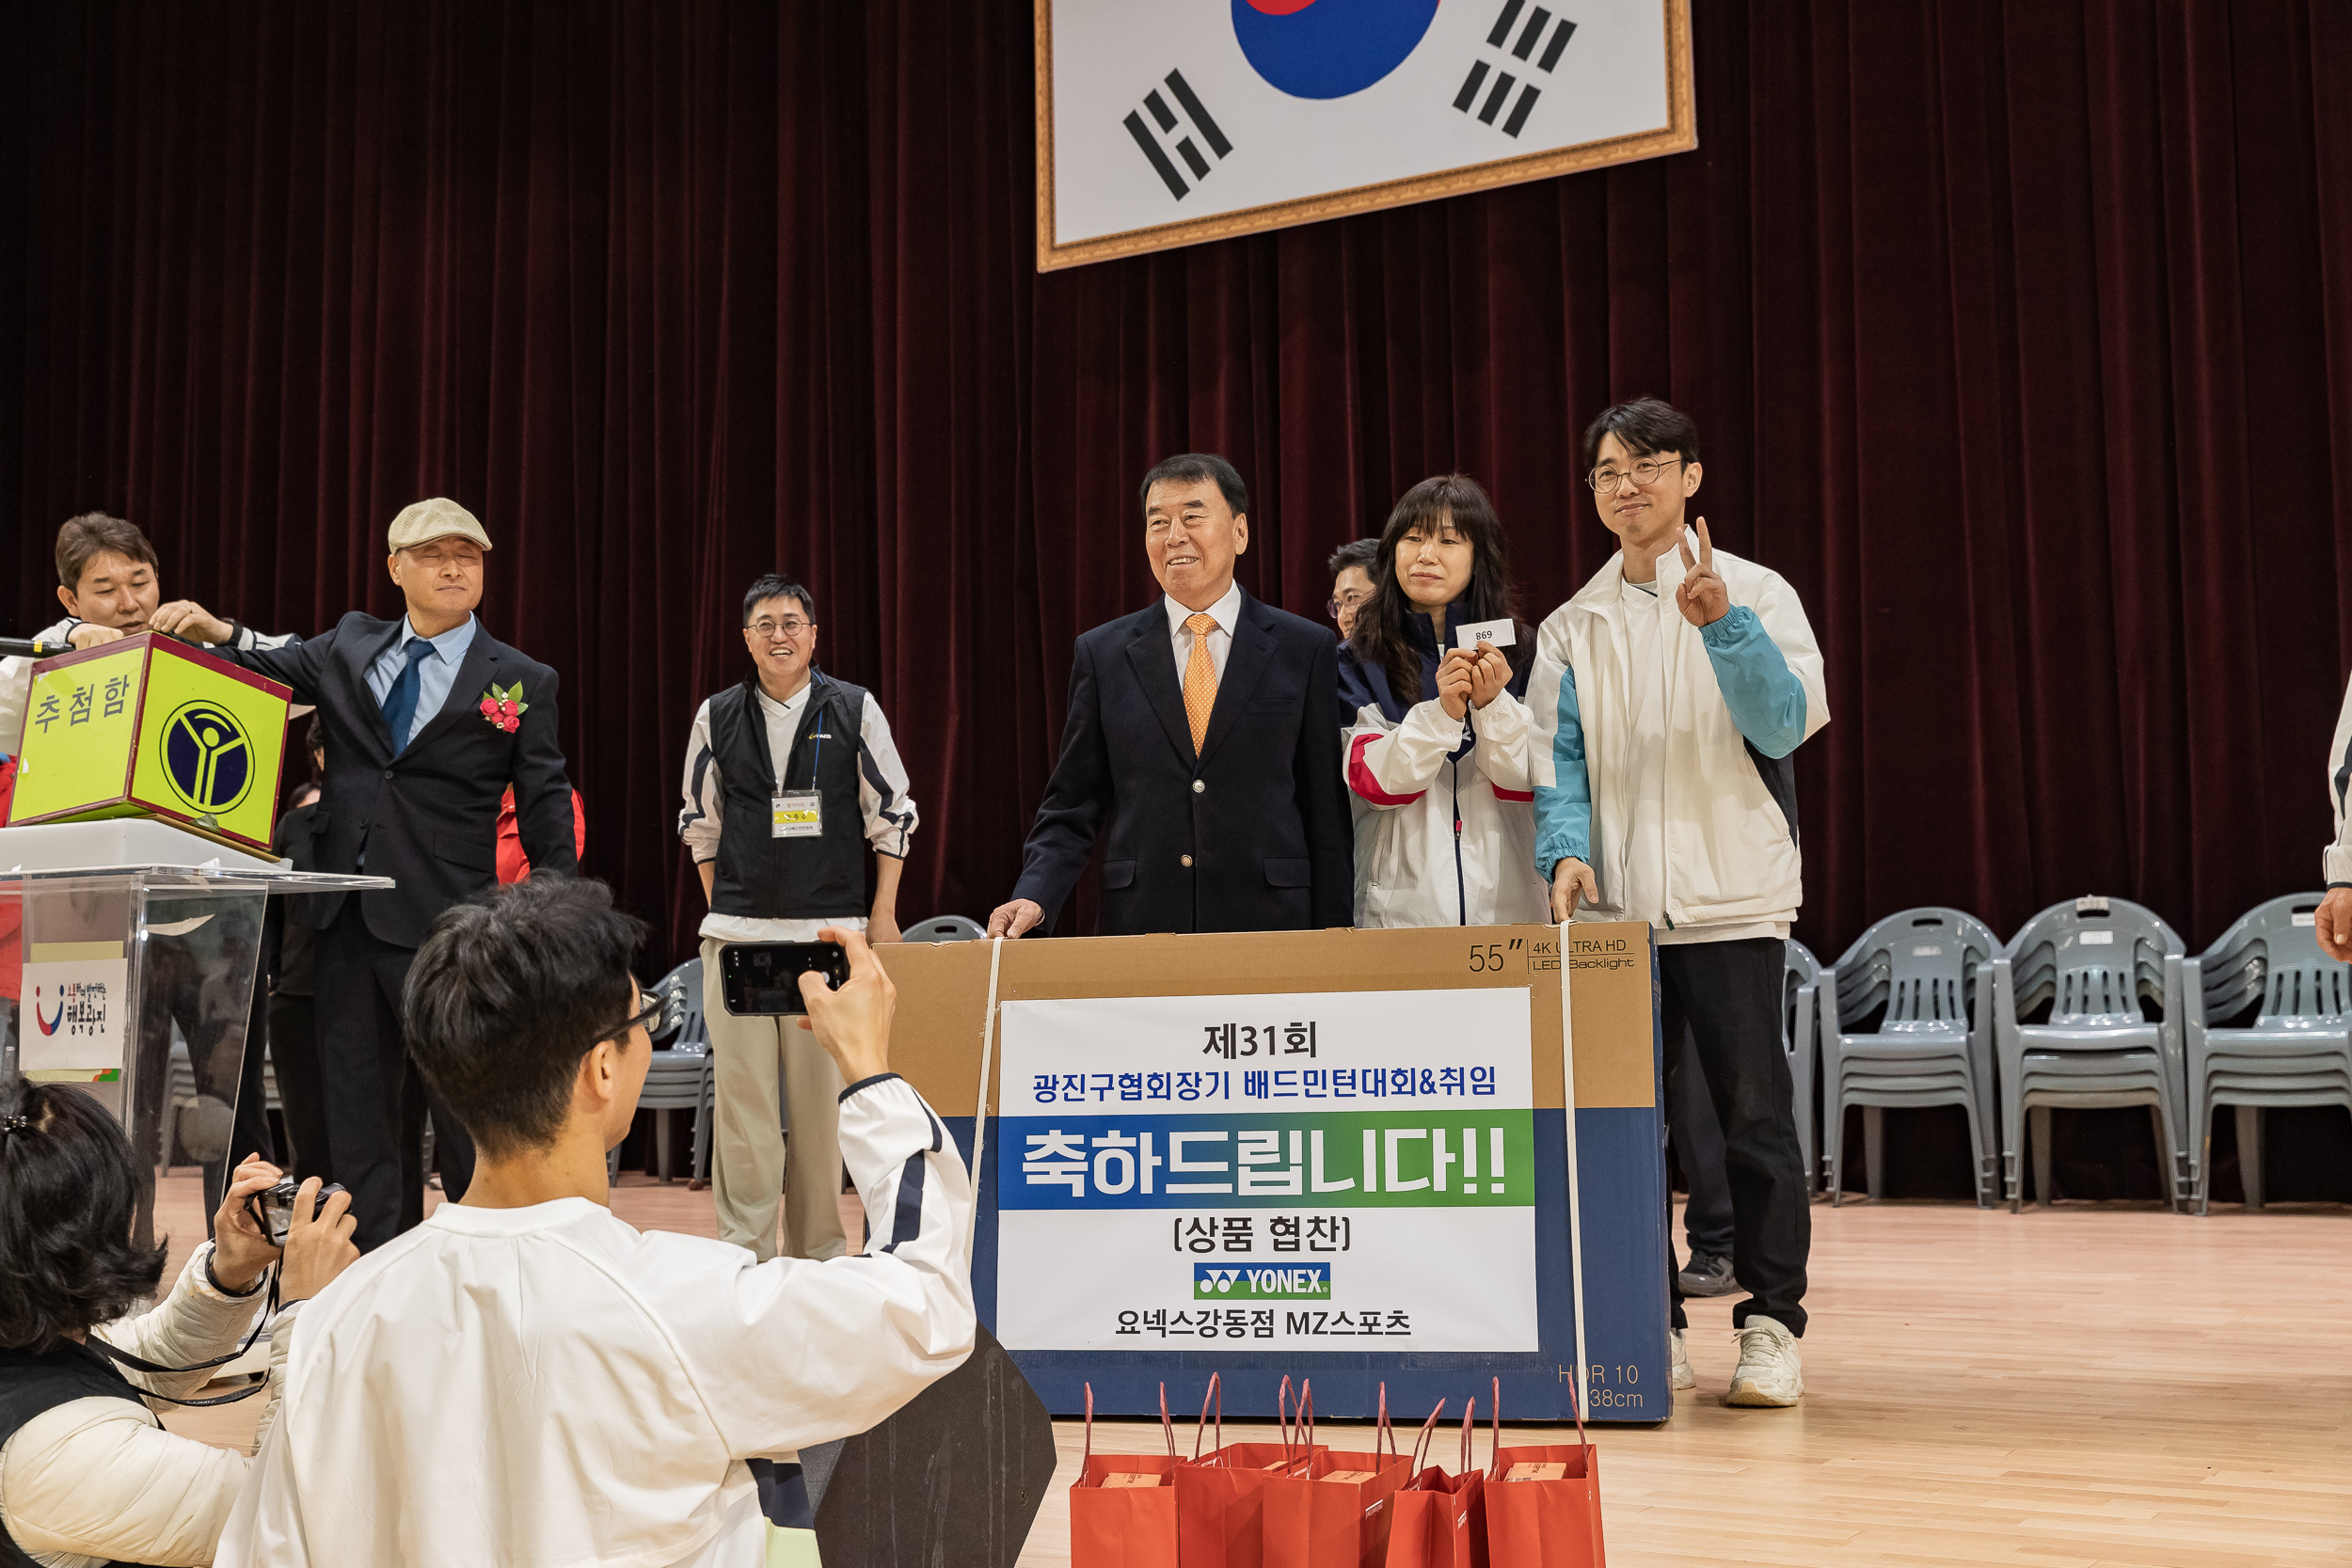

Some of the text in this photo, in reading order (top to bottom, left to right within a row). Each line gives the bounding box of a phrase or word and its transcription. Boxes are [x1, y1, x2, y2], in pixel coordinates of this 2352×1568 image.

[1475, 630, 1492, 640] 869
[35, 674, 130, 734] 추첨함
[1533, 942, 1551, 955] 4K
[1605, 939, 1627, 952] HD
[1533, 958, 1635, 971] LED Backlight
[67, 1001, 106, 1037] 행복광진
[1202, 1021, 1317, 1060] 제31회
[1033, 1066, 1496, 1103] 광진구협회장기 배드민턴대회&취임
[1022, 1127, 1506, 1197] 축하드립니다!!
[1246, 1269, 1322, 1293] YONEX
[1115, 1309, 1412, 1338] 요넥스강동점 MZ스포츠
[1615, 1365, 1639, 1385] 10
